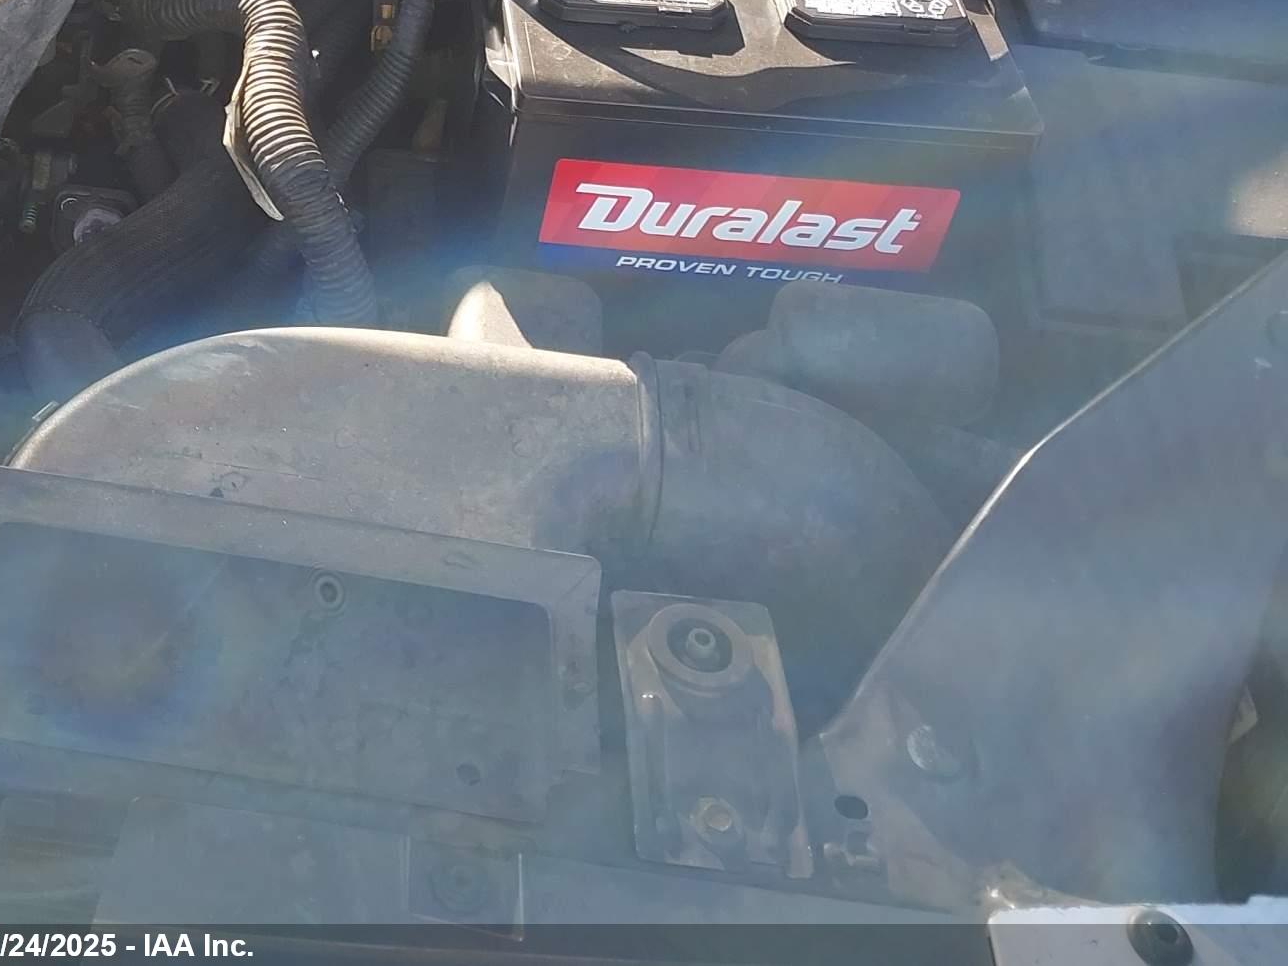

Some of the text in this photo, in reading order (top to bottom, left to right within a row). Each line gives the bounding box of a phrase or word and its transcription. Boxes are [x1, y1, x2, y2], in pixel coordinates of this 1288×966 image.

[575, 182, 922, 254] Duralast
[615, 255, 844, 284] PROVEN TOUGH
